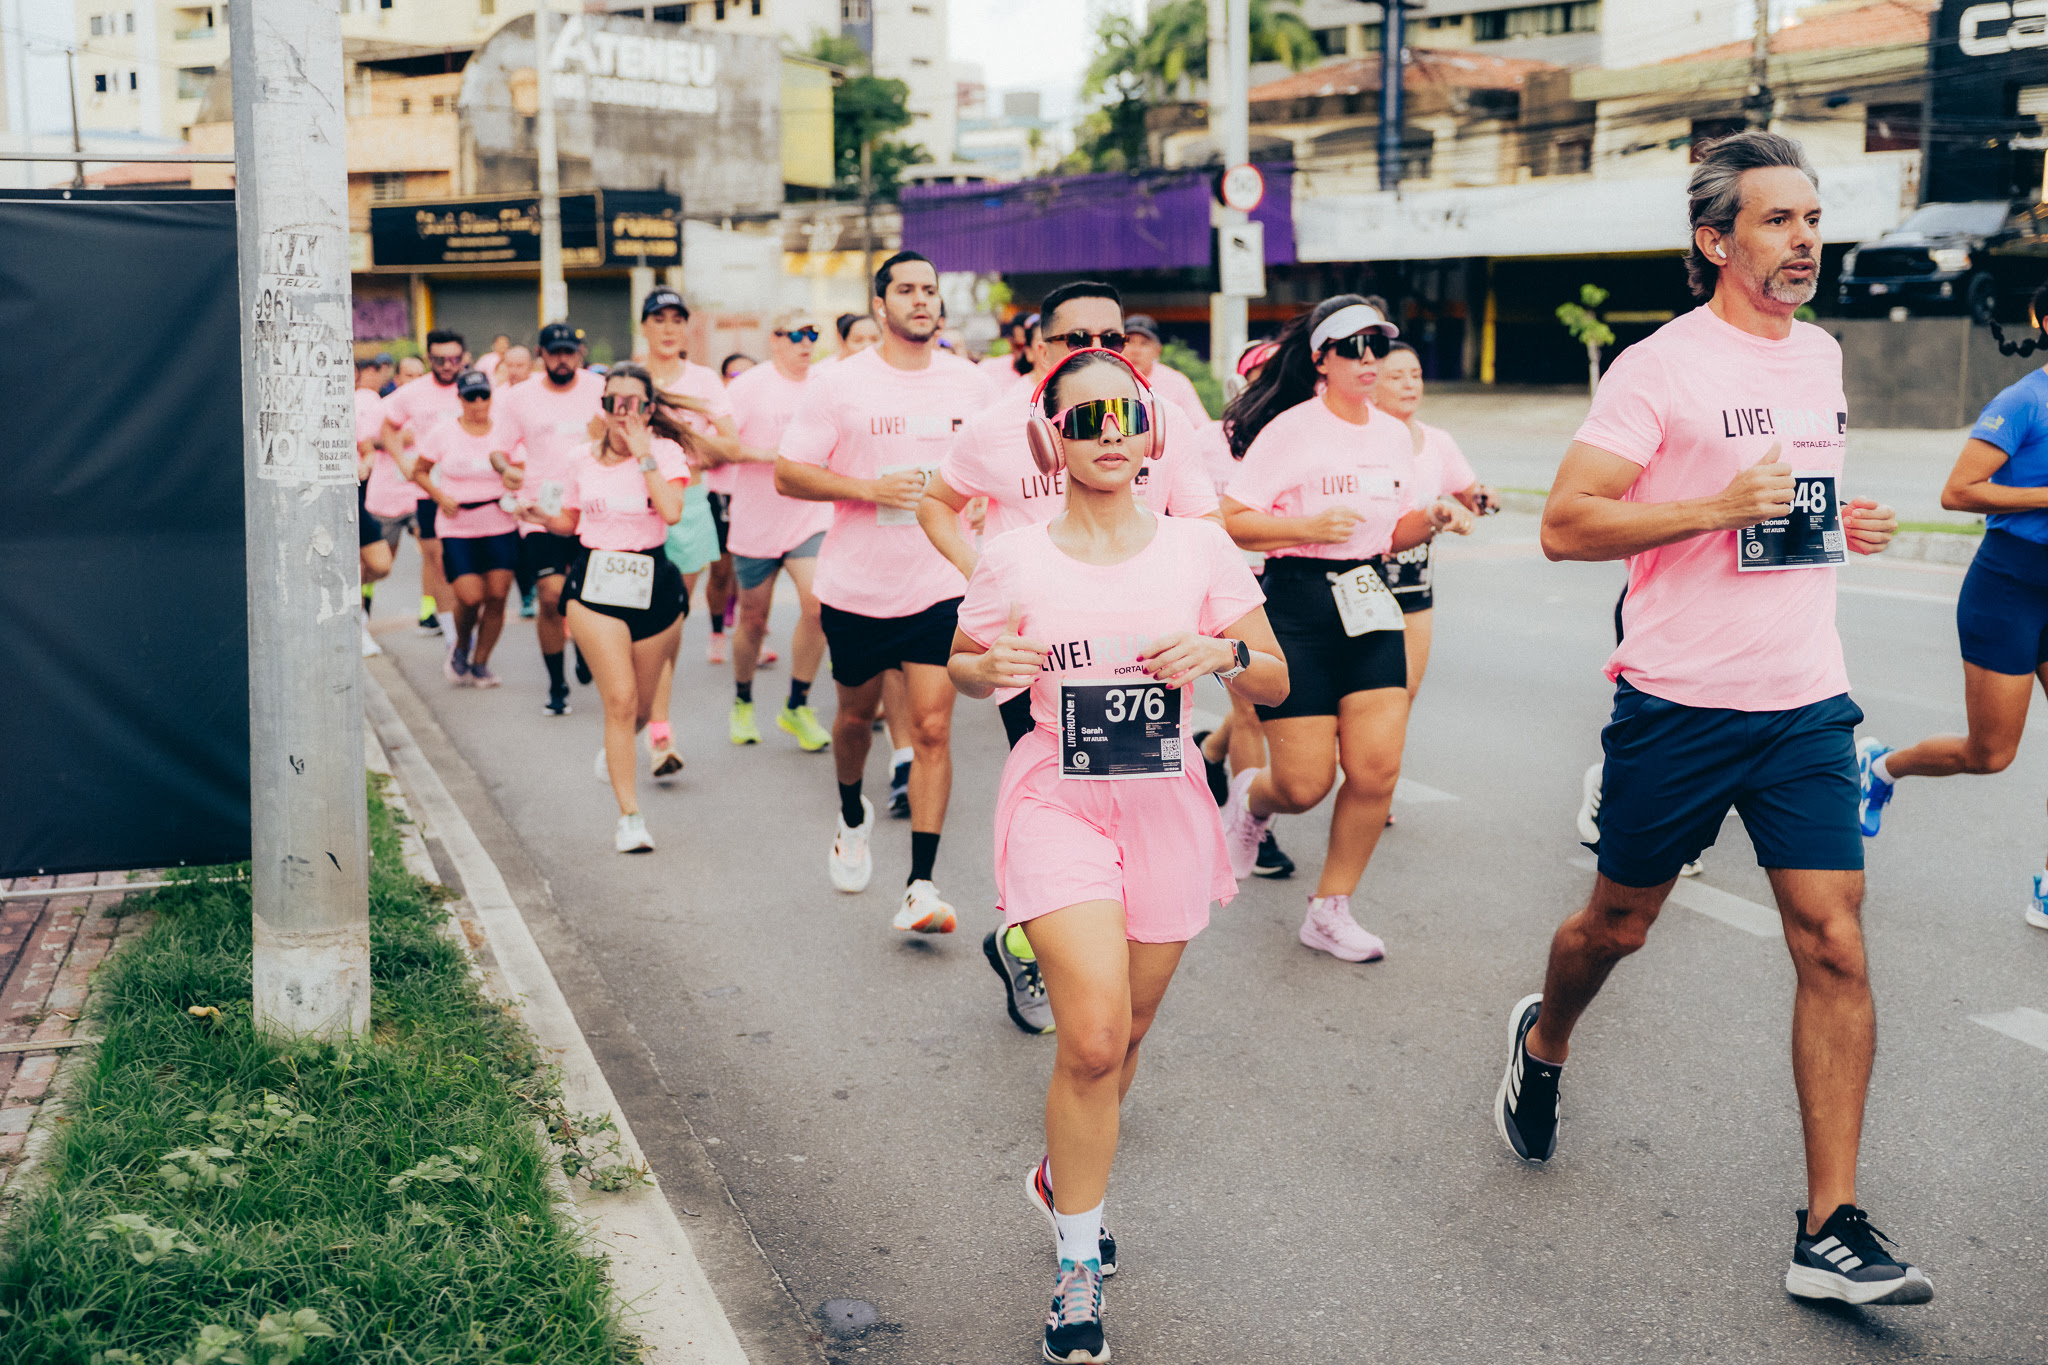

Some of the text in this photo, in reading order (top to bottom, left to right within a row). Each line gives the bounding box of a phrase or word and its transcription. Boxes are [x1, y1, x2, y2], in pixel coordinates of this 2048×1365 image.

[1722, 408, 1775, 438] LIVE!
[1793, 440, 1832, 448] FORTALEZA
[1322, 475, 1359, 495] LIVE!
[1789, 481, 1827, 514] 48
[605, 557, 649, 578] 5345
[1105, 688, 1165, 723] 376
[1081, 727, 1104, 735] Sarah
